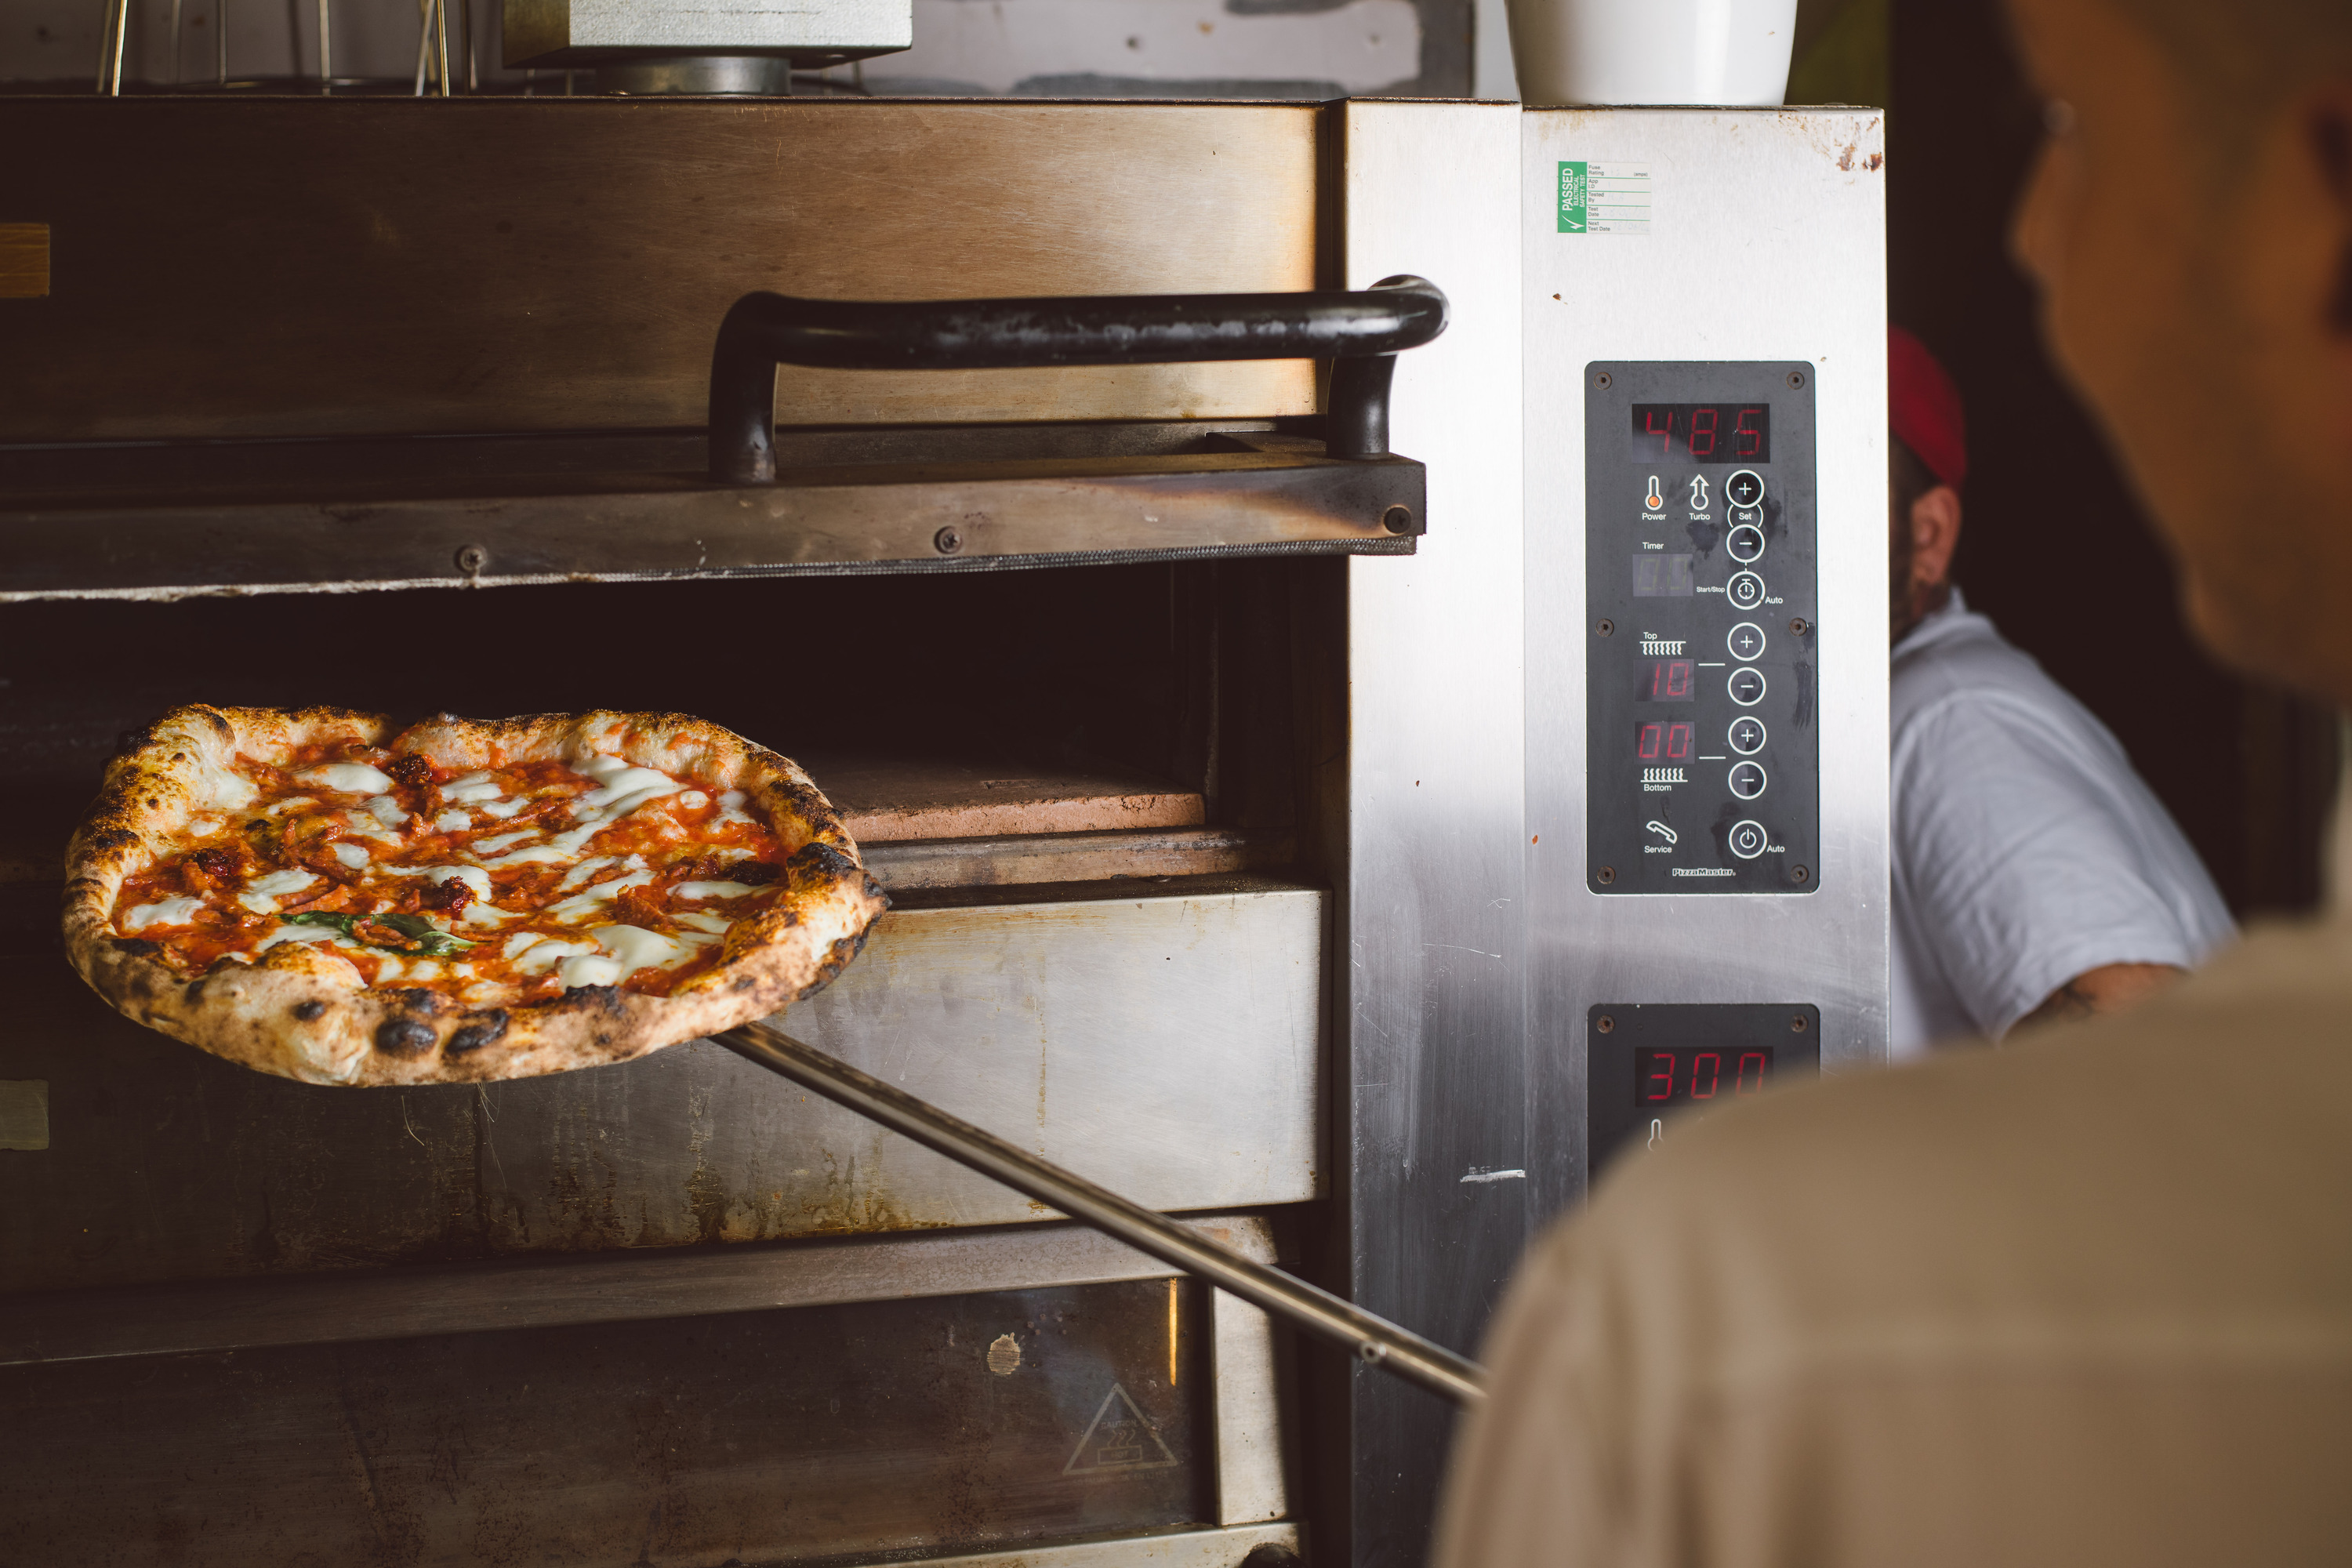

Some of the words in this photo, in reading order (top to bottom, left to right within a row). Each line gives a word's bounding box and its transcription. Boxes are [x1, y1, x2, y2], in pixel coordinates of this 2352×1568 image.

[1562, 168, 1573, 211] PASSED
[1646, 408, 1762, 456] 485
[1642, 513, 1667, 521] Power
[1738, 512, 1752, 521] Set
[1696, 586, 1726, 594] Start/Stop
[1643, 632, 1657, 641] Top
[1653, 662, 1689, 696] 10
[1638, 724, 1690, 758] 00
[1647, 1052, 1766, 1100] 300
[1101, 1419, 1138, 1429] CAUTION
[1110, 1450, 1129, 1459] HOT
